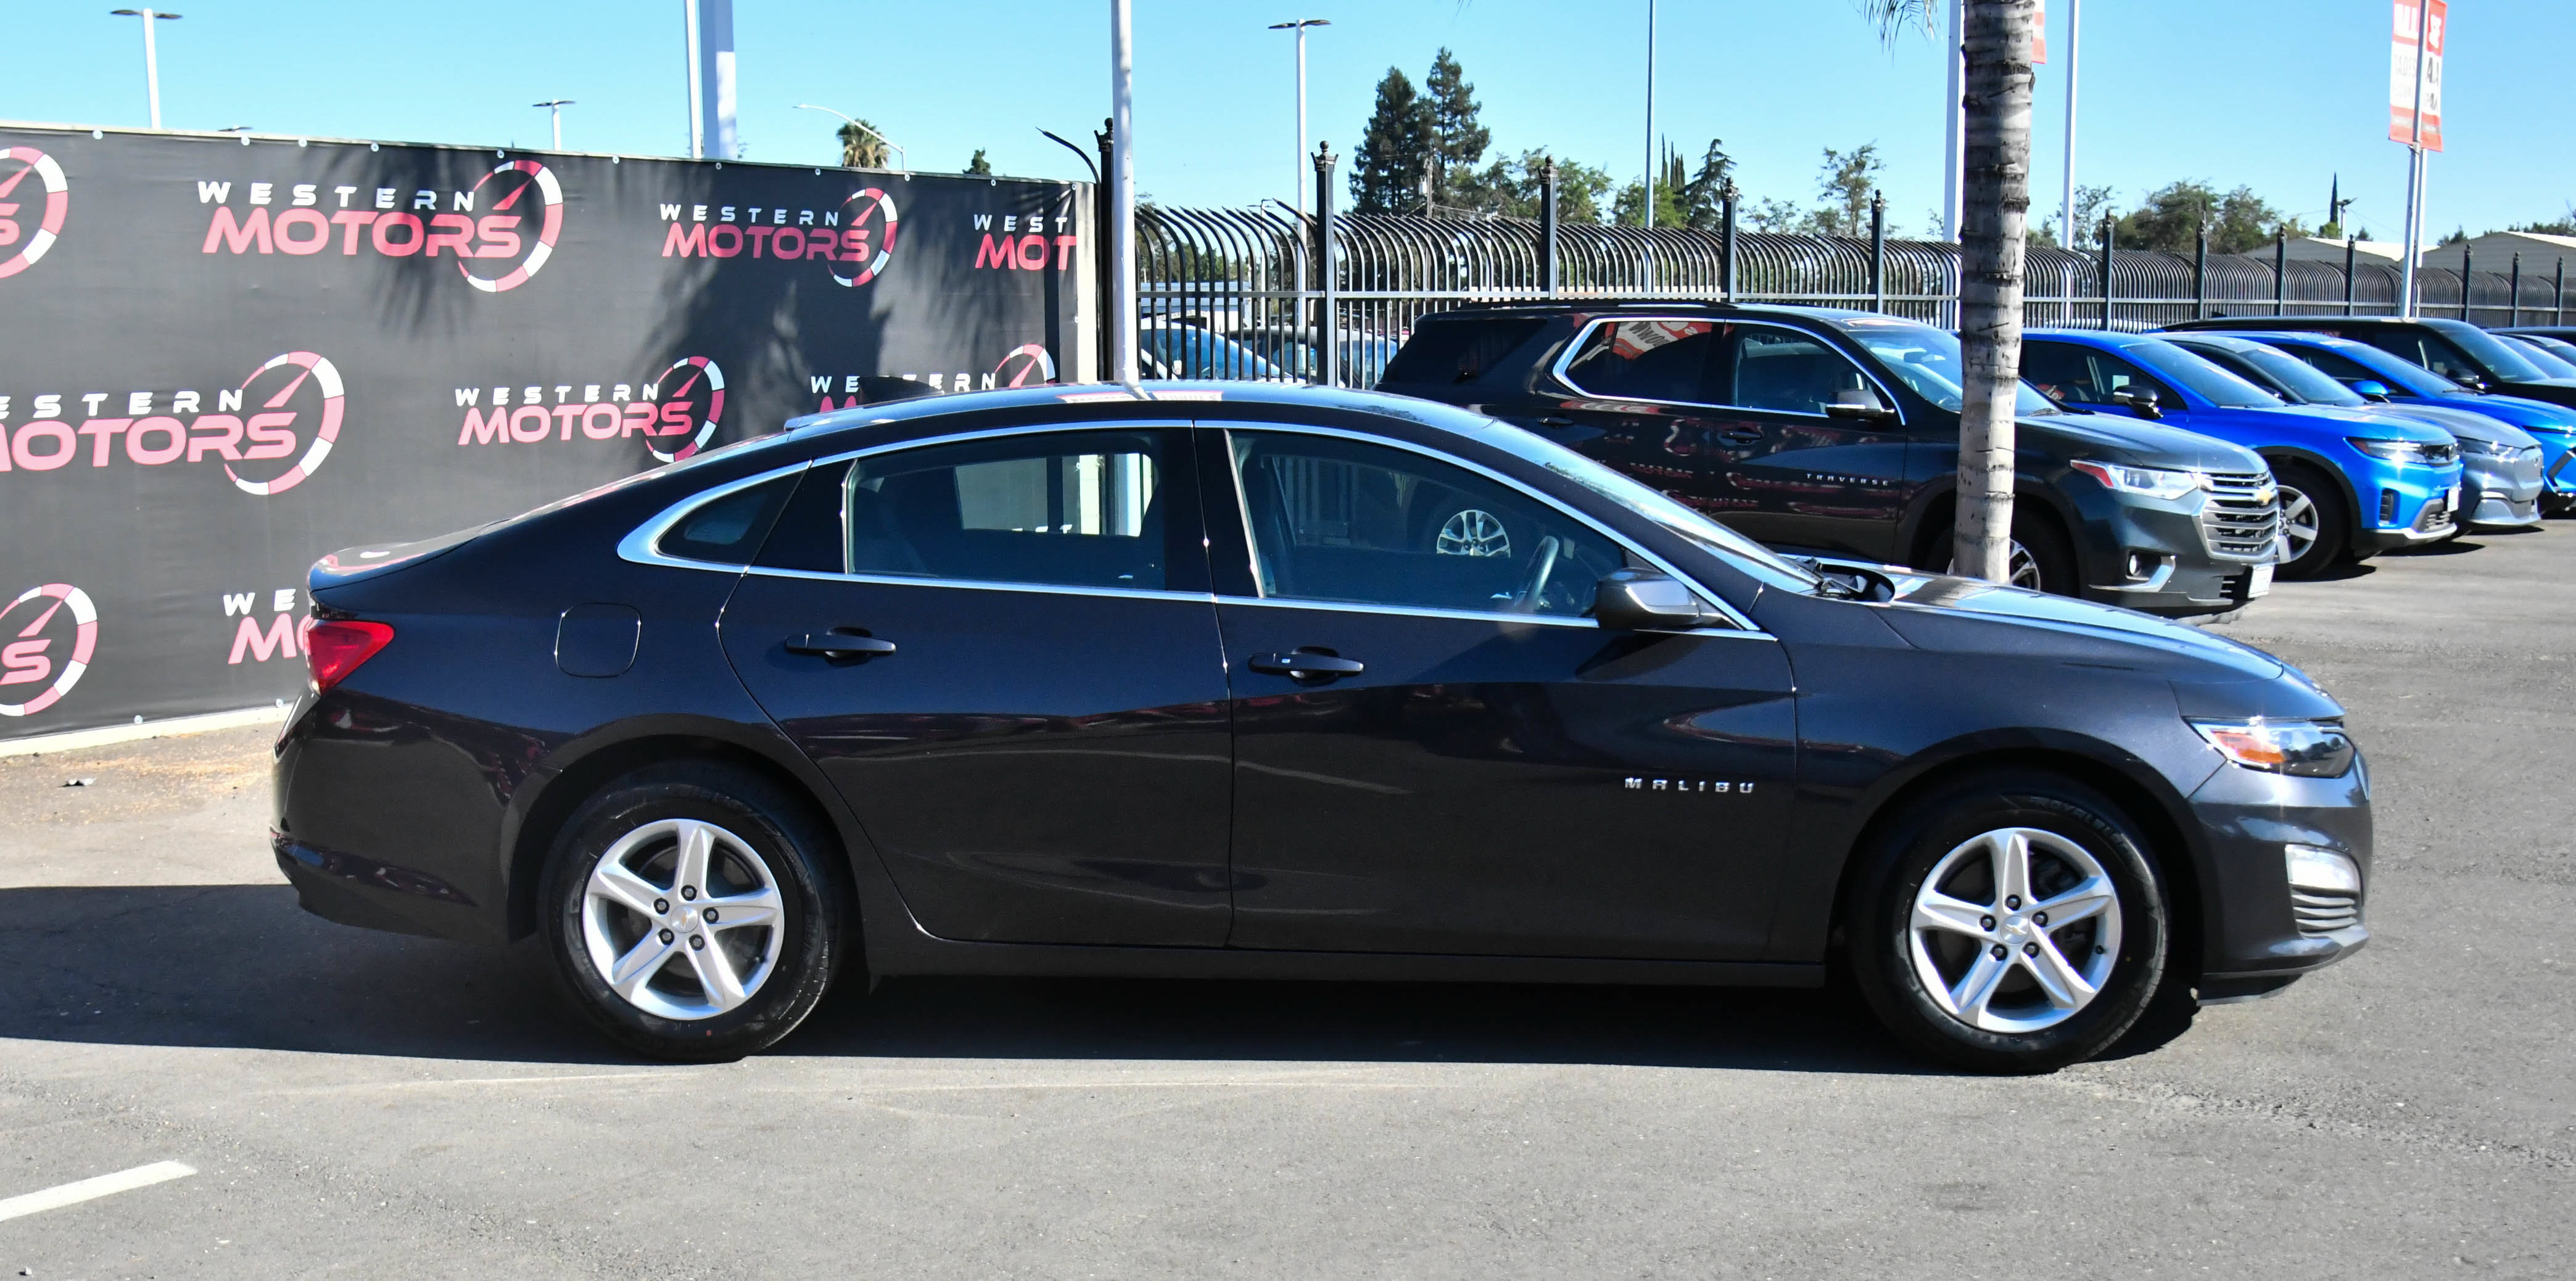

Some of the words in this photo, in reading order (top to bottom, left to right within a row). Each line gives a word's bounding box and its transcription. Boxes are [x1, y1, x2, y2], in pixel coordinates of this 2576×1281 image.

[198, 181, 476, 212] WESTERN
[660, 203, 839, 227] WESTERN
[973, 214, 1068, 233] WEST
[202, 206, 522, 258] MOTORS
[662, 222, 870, 262] MOTORS
[455, 383, 659, 407] WESTERN
[811, 372, 996, 394] WEERN
[457, 402, 693, 446] MOTORS
[0, 411, 297, 472] OTORS
[1806, 473, 1889, 487] TRAVERSE
[1624, 777, 1754, 794] MALIBU
